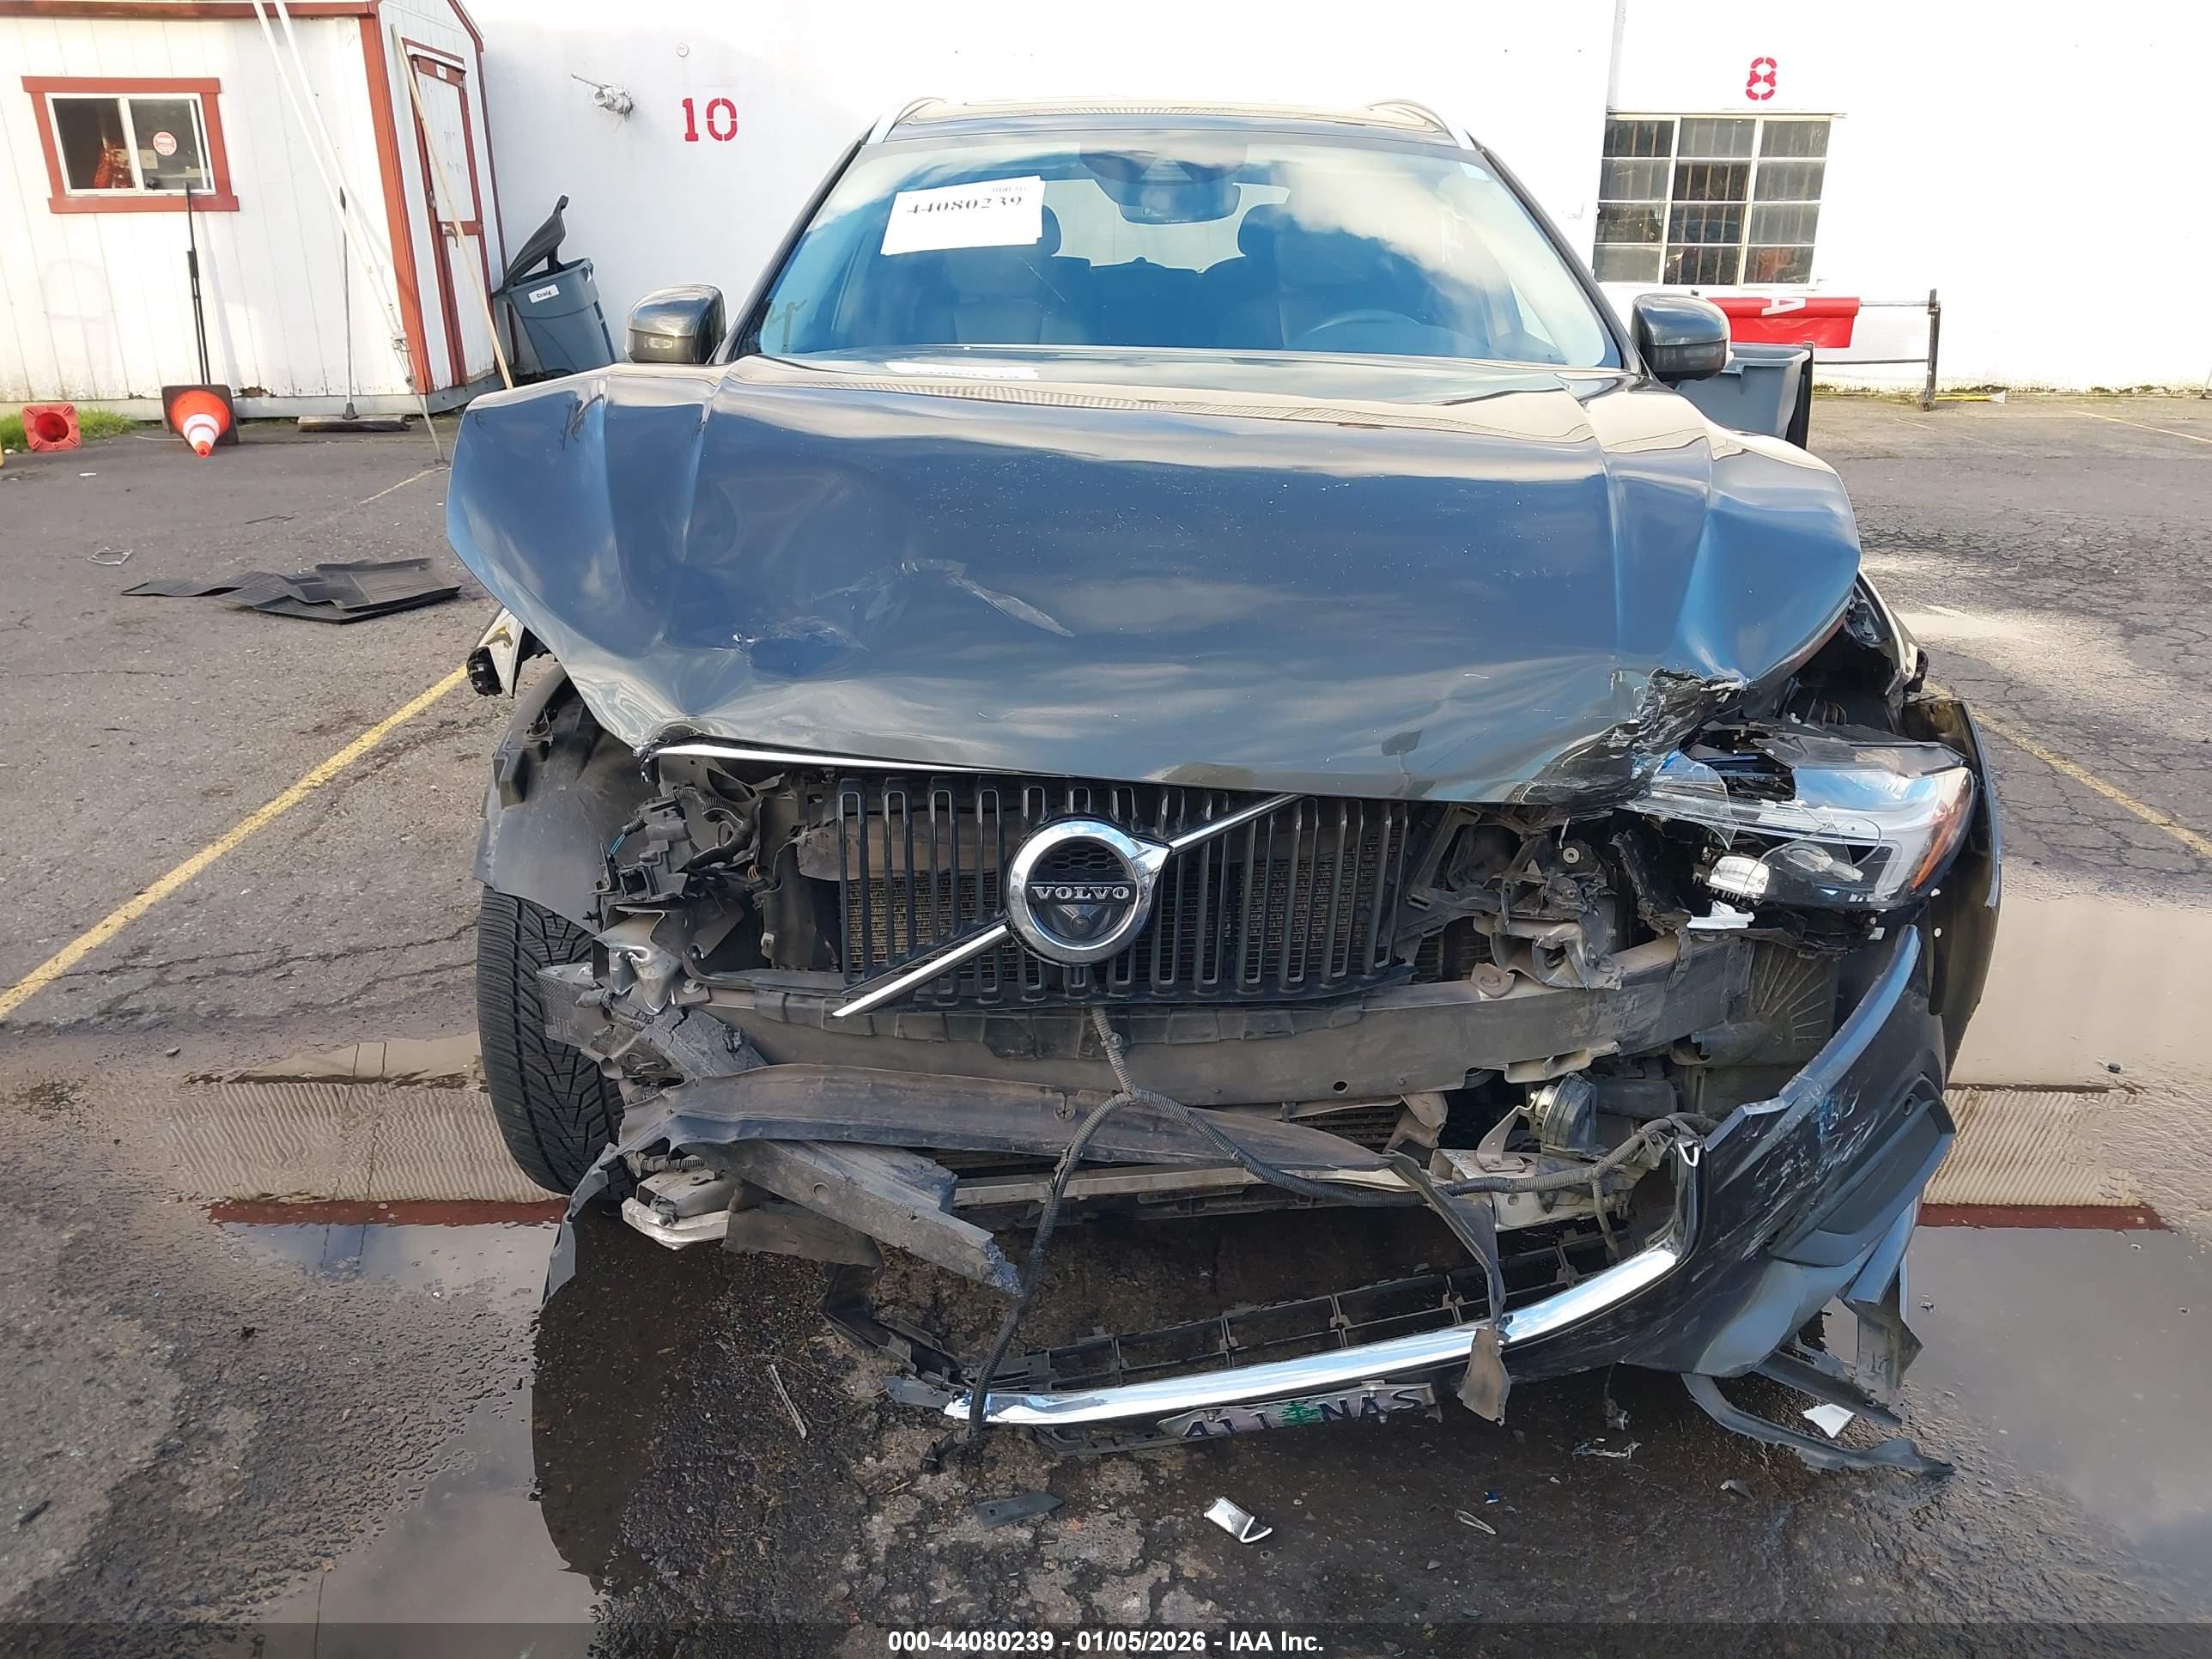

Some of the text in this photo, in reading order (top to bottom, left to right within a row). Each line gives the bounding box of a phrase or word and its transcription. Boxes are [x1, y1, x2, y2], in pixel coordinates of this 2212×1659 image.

[1746, 58, 1777, 100] 8
[683, 98, 737, 141] 10
[907, 196, 1022, 214] 44080239
[1032, 886, 1129, 900] VOLVO
